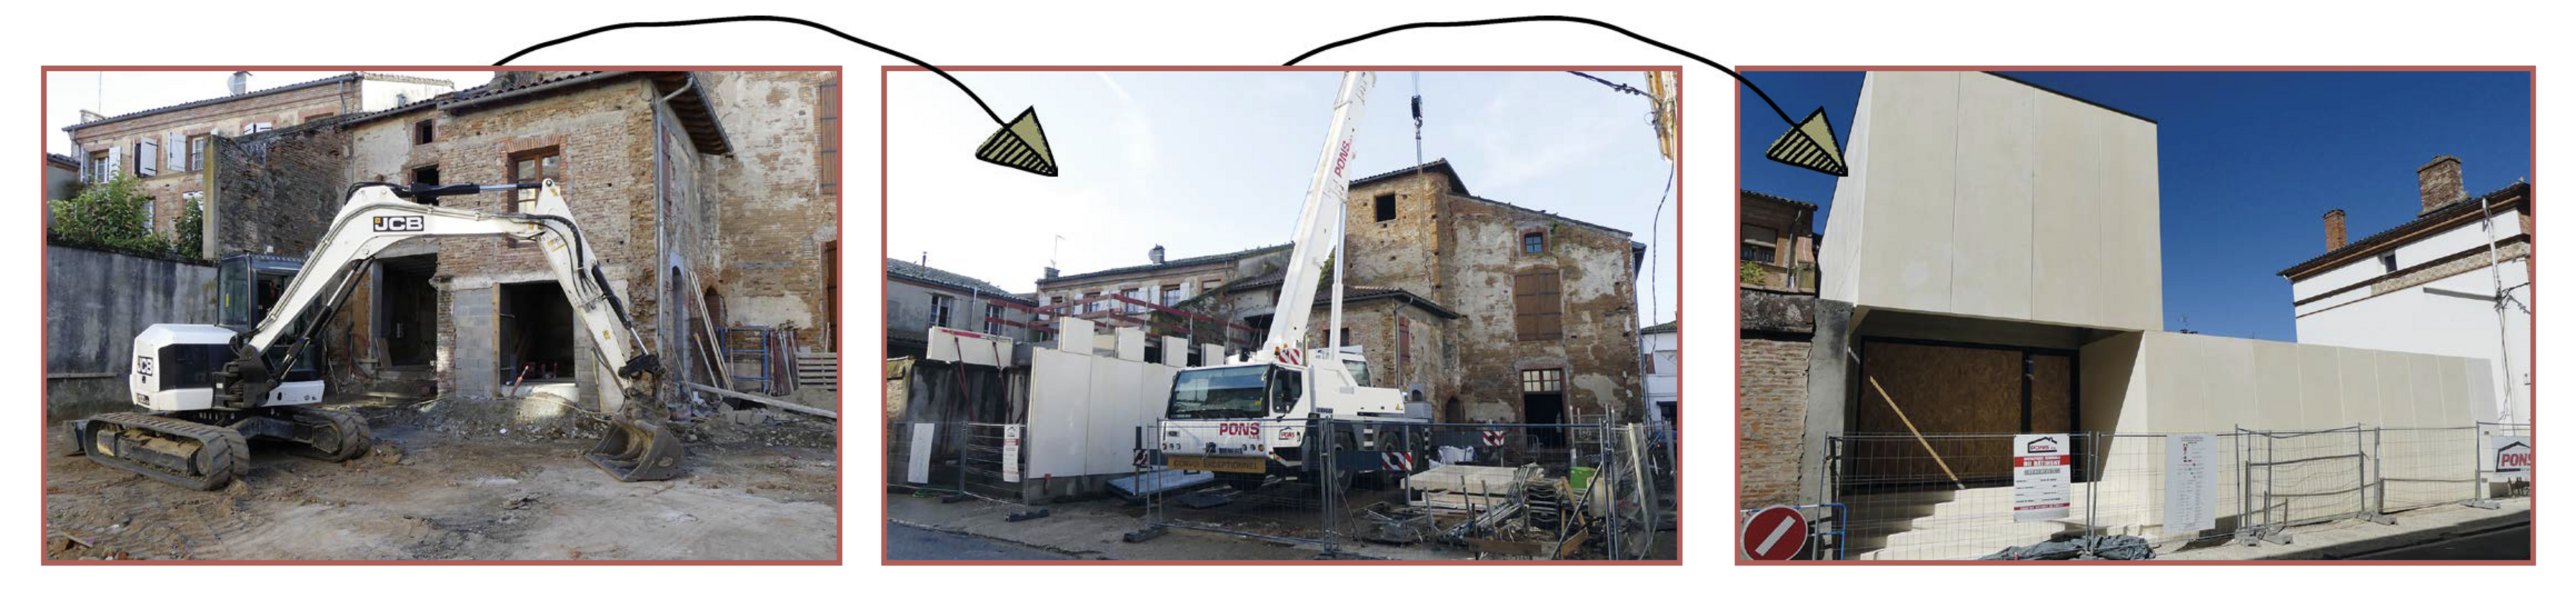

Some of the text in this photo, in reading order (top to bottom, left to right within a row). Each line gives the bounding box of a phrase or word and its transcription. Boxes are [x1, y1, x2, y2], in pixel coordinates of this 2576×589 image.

[1334, 140, 1350, 178] PONS
[374, 217, 422, 230] JCB
[1220, 423, 1260, 436] PONS
